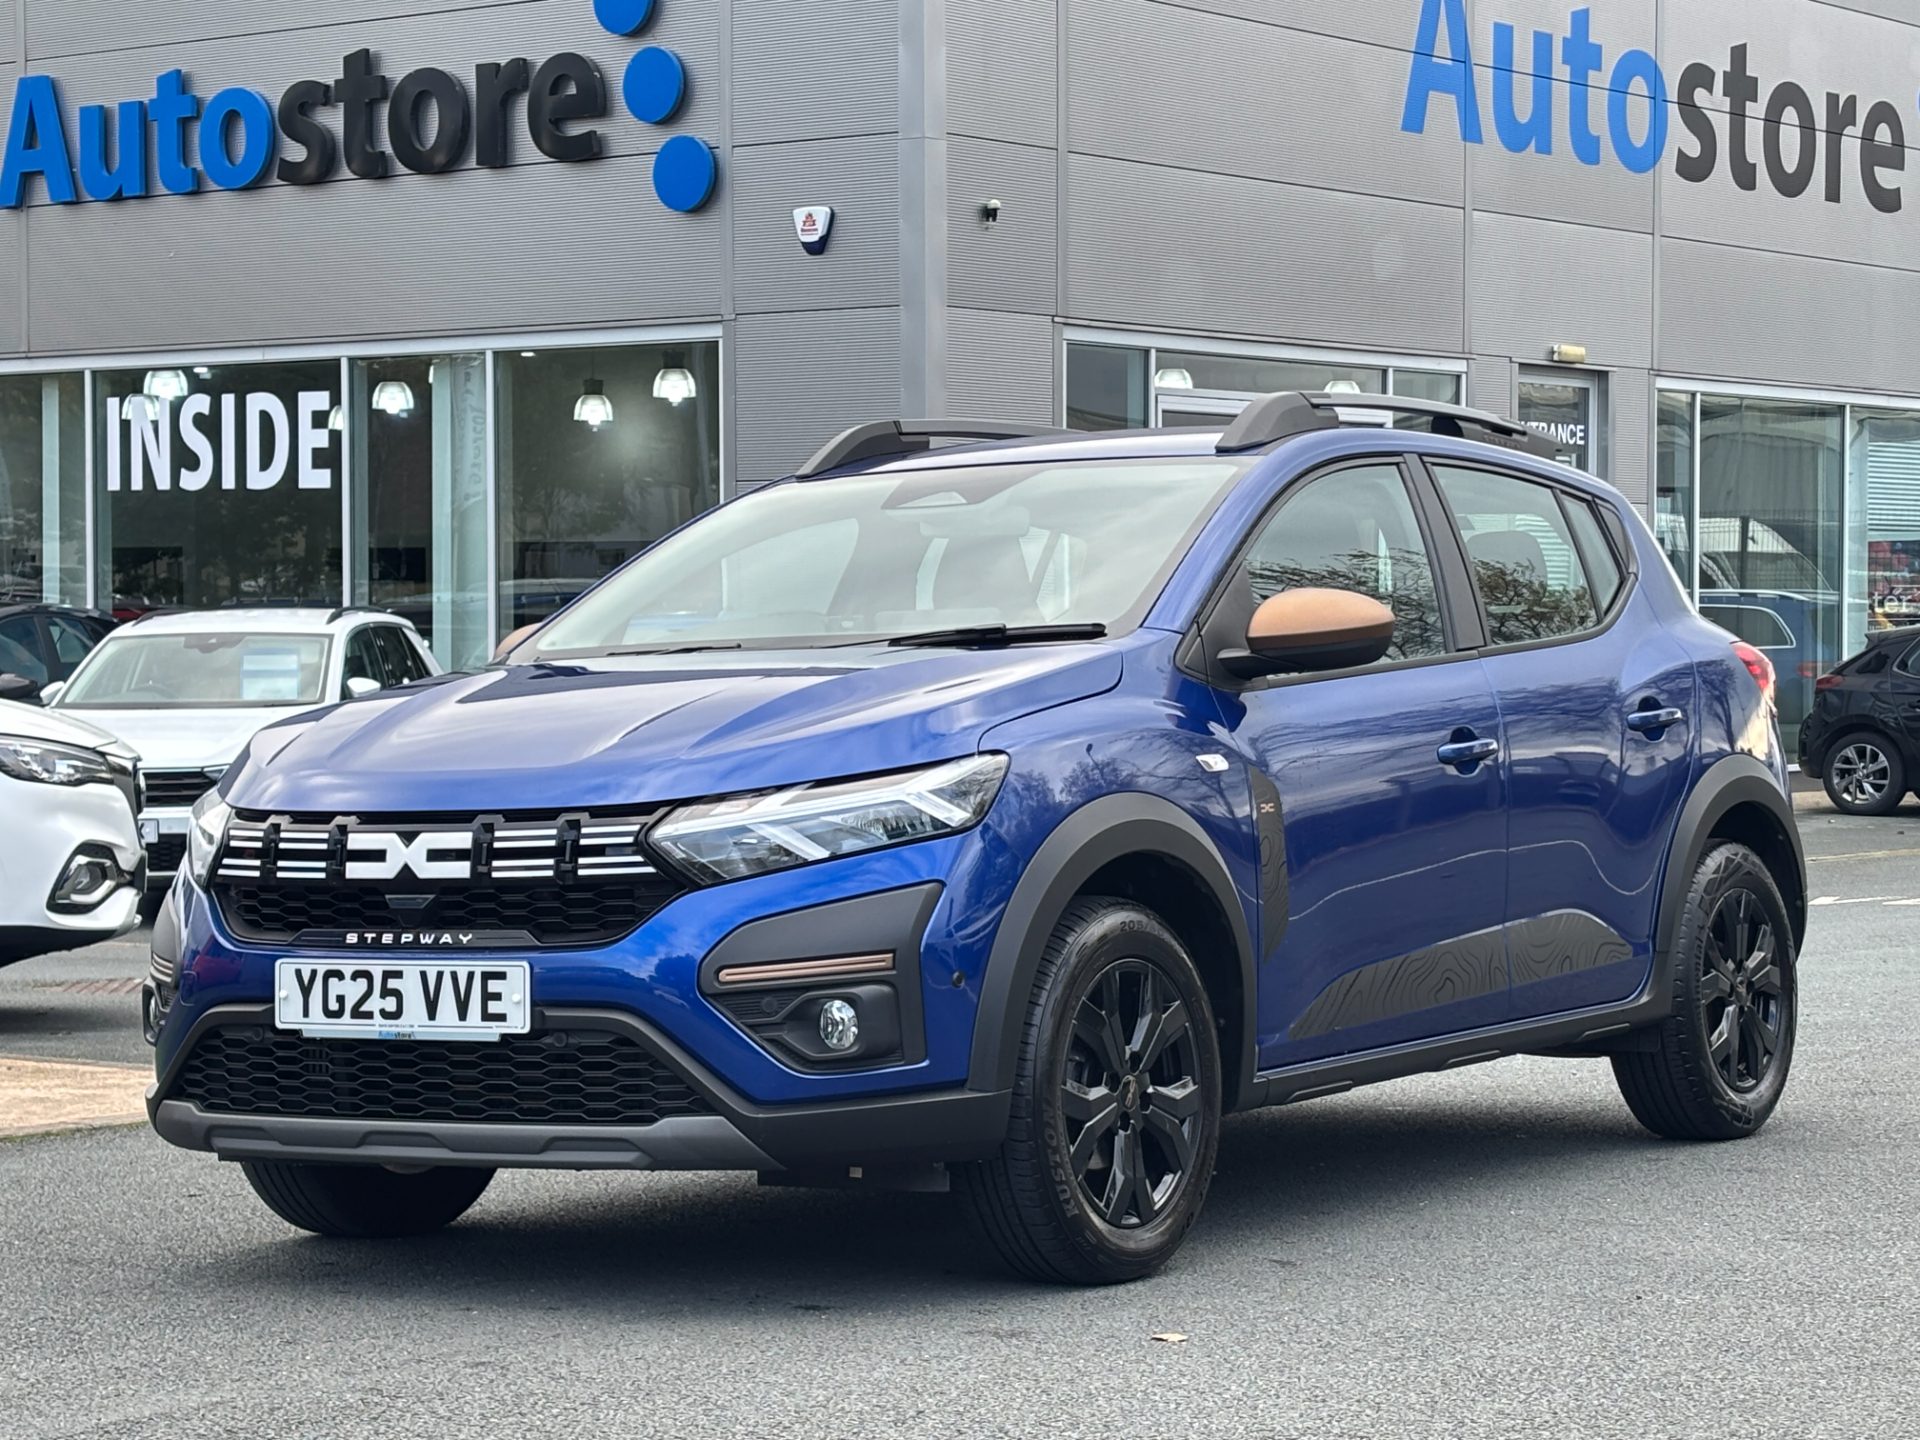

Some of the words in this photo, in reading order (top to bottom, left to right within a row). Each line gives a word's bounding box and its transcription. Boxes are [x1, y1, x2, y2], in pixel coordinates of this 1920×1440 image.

[0, 47, 606, 209] Autostore
[1401, 0, 1906, 214] Autostore
[106, 390, 331, 492] INSIDE
[345, 932, 473, 945] STEPWAY
[294, 968, 404, 1021] YG25
[419, 970, 508, 1023] VVE
